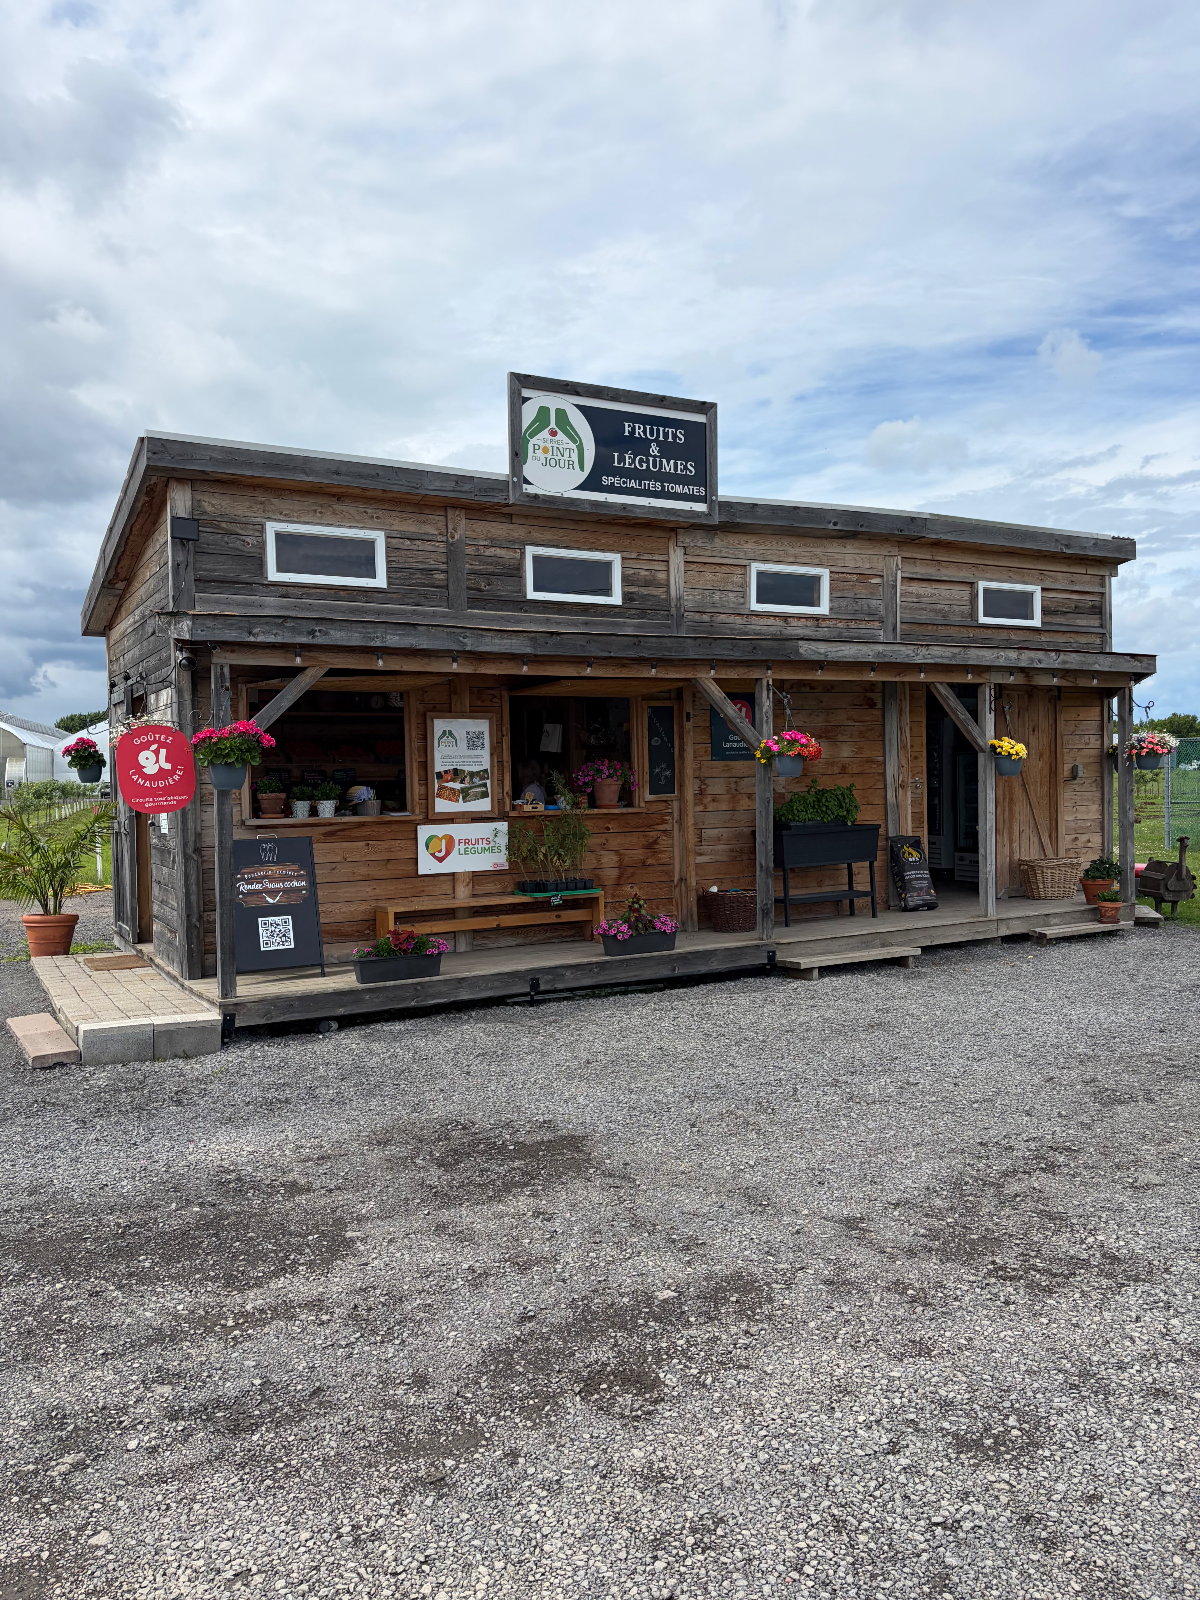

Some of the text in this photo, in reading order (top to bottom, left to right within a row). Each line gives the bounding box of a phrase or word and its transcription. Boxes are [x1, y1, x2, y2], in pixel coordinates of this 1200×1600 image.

[623, 422, 685, 443] FRUITS
[542, 437, 564, 446] SERRES
[649, 442, 661, 456] &
[541, 456, 576, 471] JOUR
[612, 451, 696, 476] LÉGUMES
[601, 476, 706, 496] SPÉCIALITÉS TOMATES
[133, 732, 174, 745] GOÛTEZ
[458, 837, 491, 847] FRUITS
[458, 845, 503, 856] LÉGUMES
